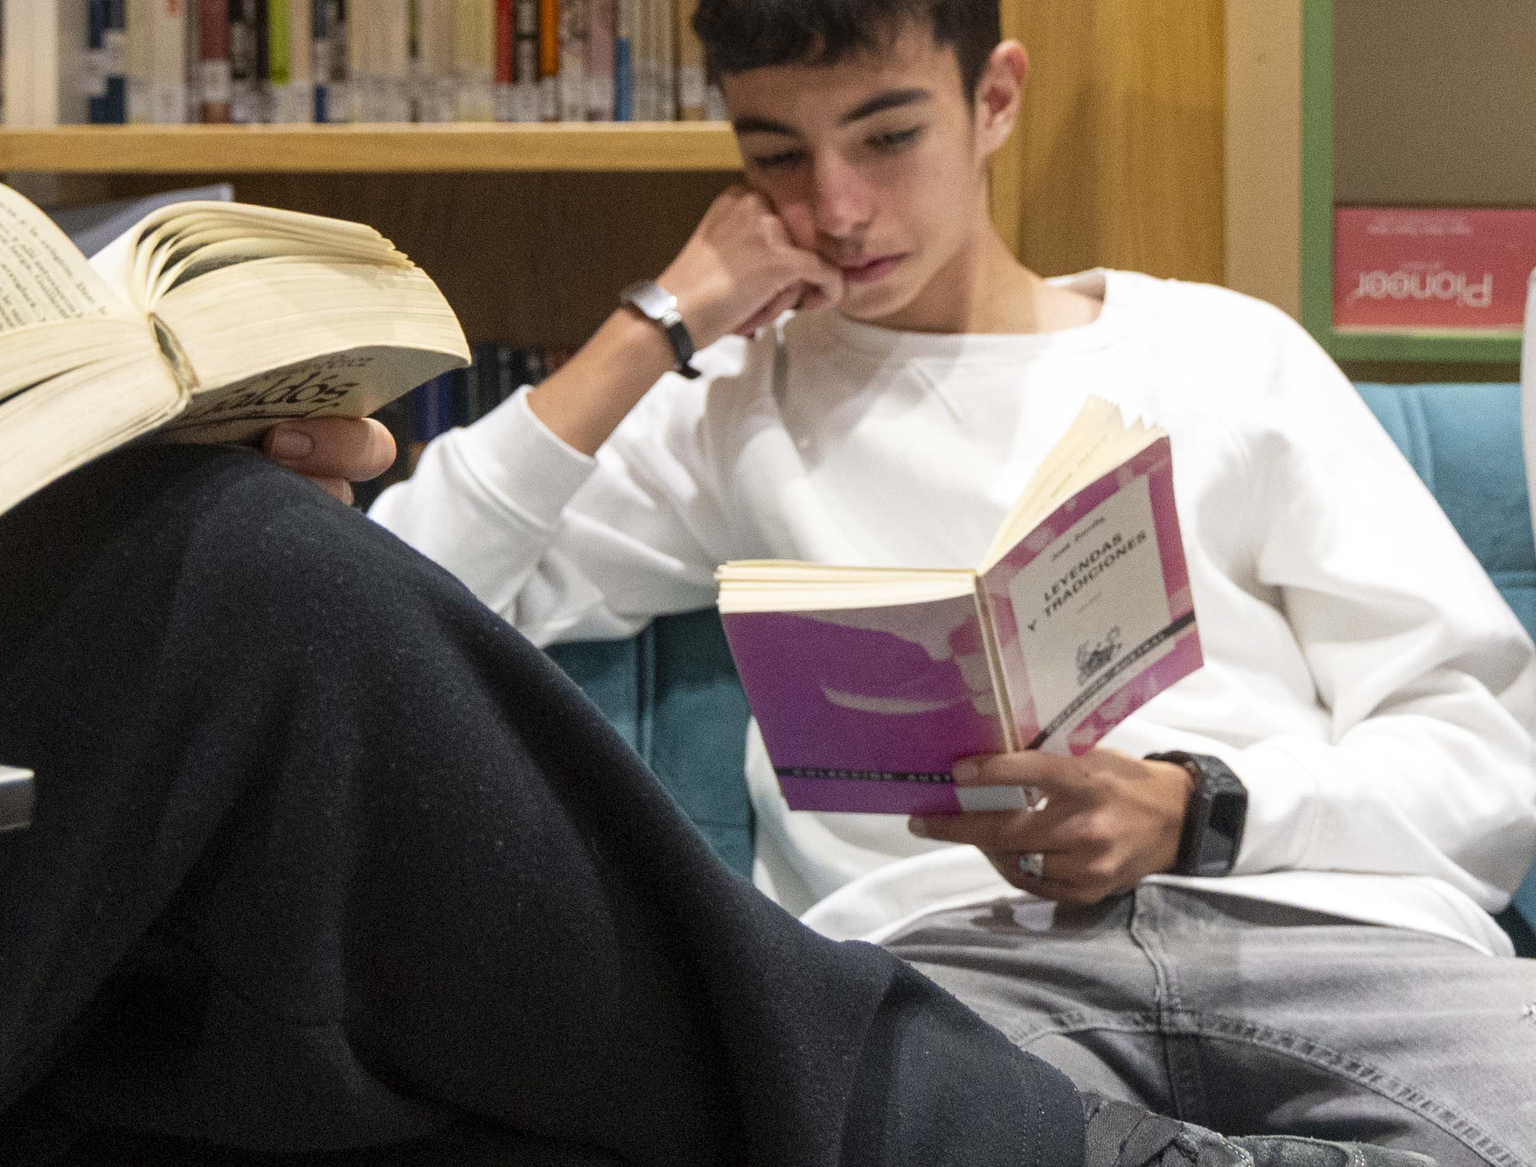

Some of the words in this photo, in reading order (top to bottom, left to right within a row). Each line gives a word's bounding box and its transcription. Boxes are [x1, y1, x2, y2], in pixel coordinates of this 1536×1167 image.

[1027, 618, 1038, 632] Y
[1044, 530, 1148, 617] TRADICIONES
[1044, 532, 1123, 602] LEYENDAS
